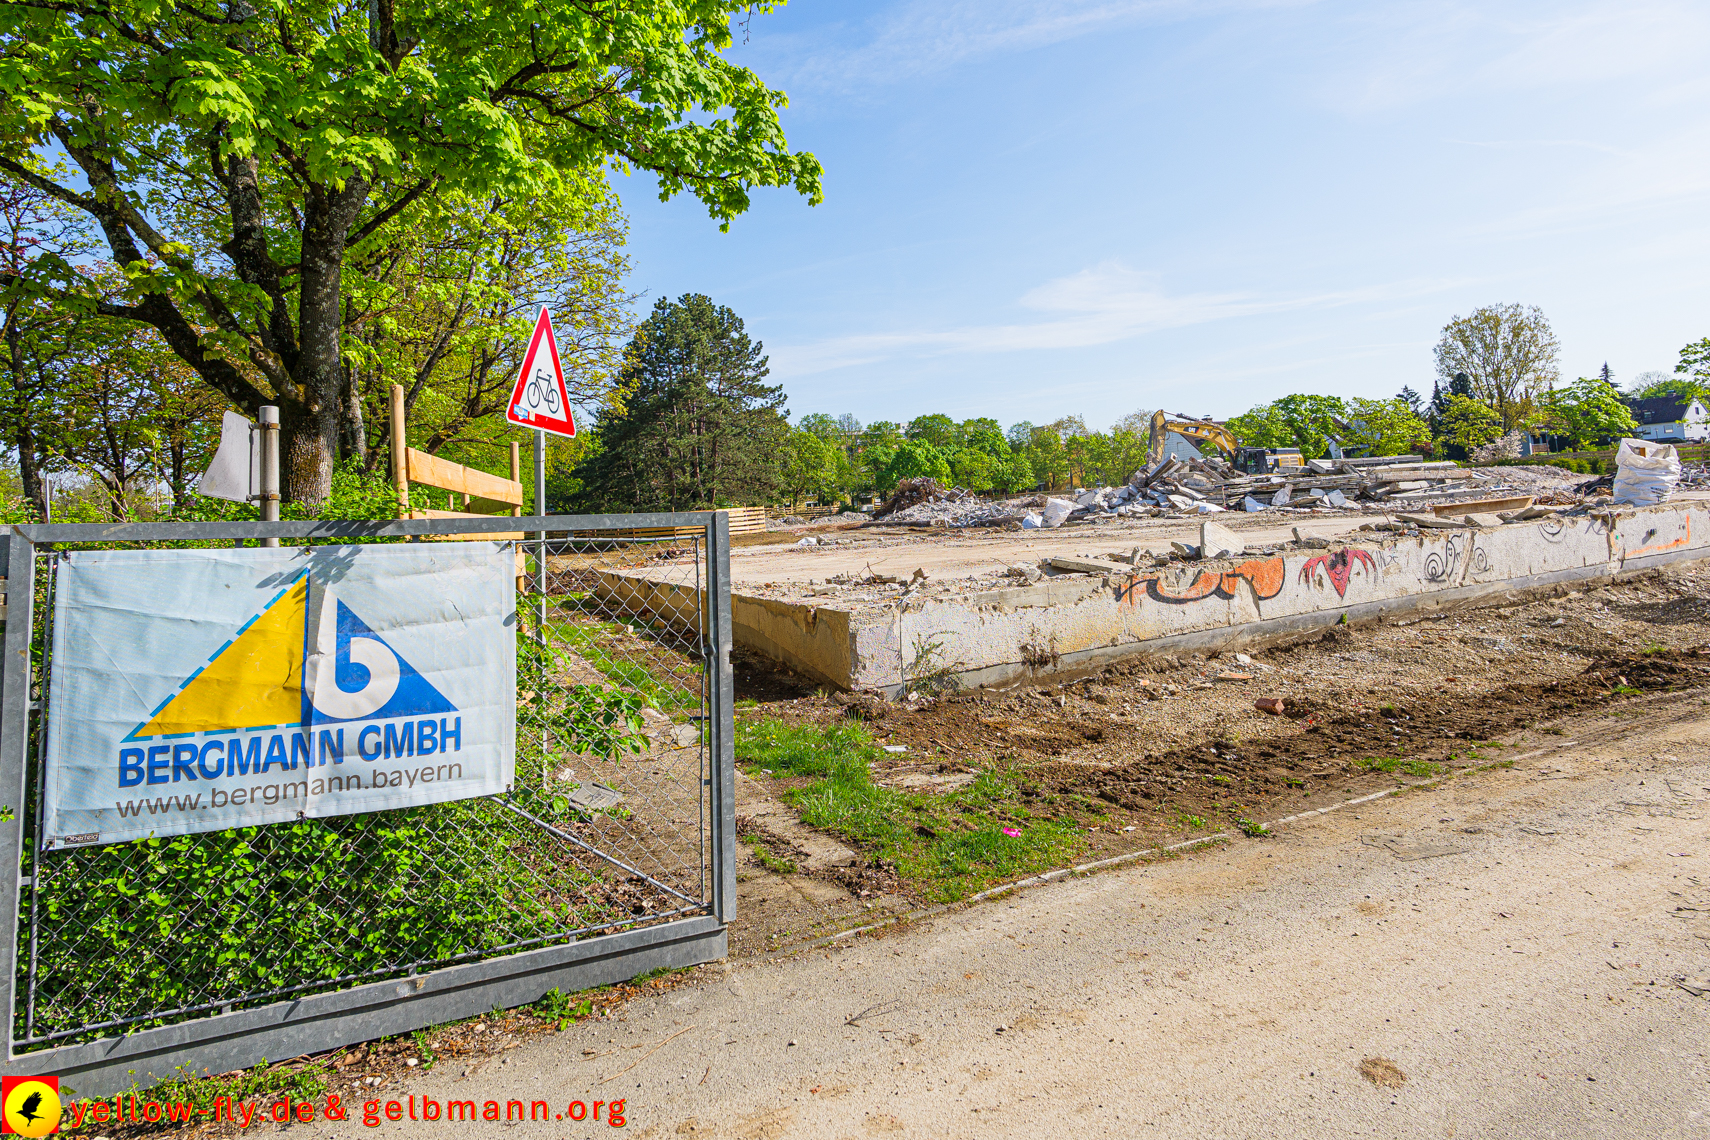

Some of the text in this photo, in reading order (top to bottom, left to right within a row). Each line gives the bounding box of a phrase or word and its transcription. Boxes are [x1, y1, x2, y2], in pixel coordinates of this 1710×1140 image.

[118, 716, 462, 788] BERGMANN GMBH
[115, 763, 463, 819] www.bergmann.bayern
